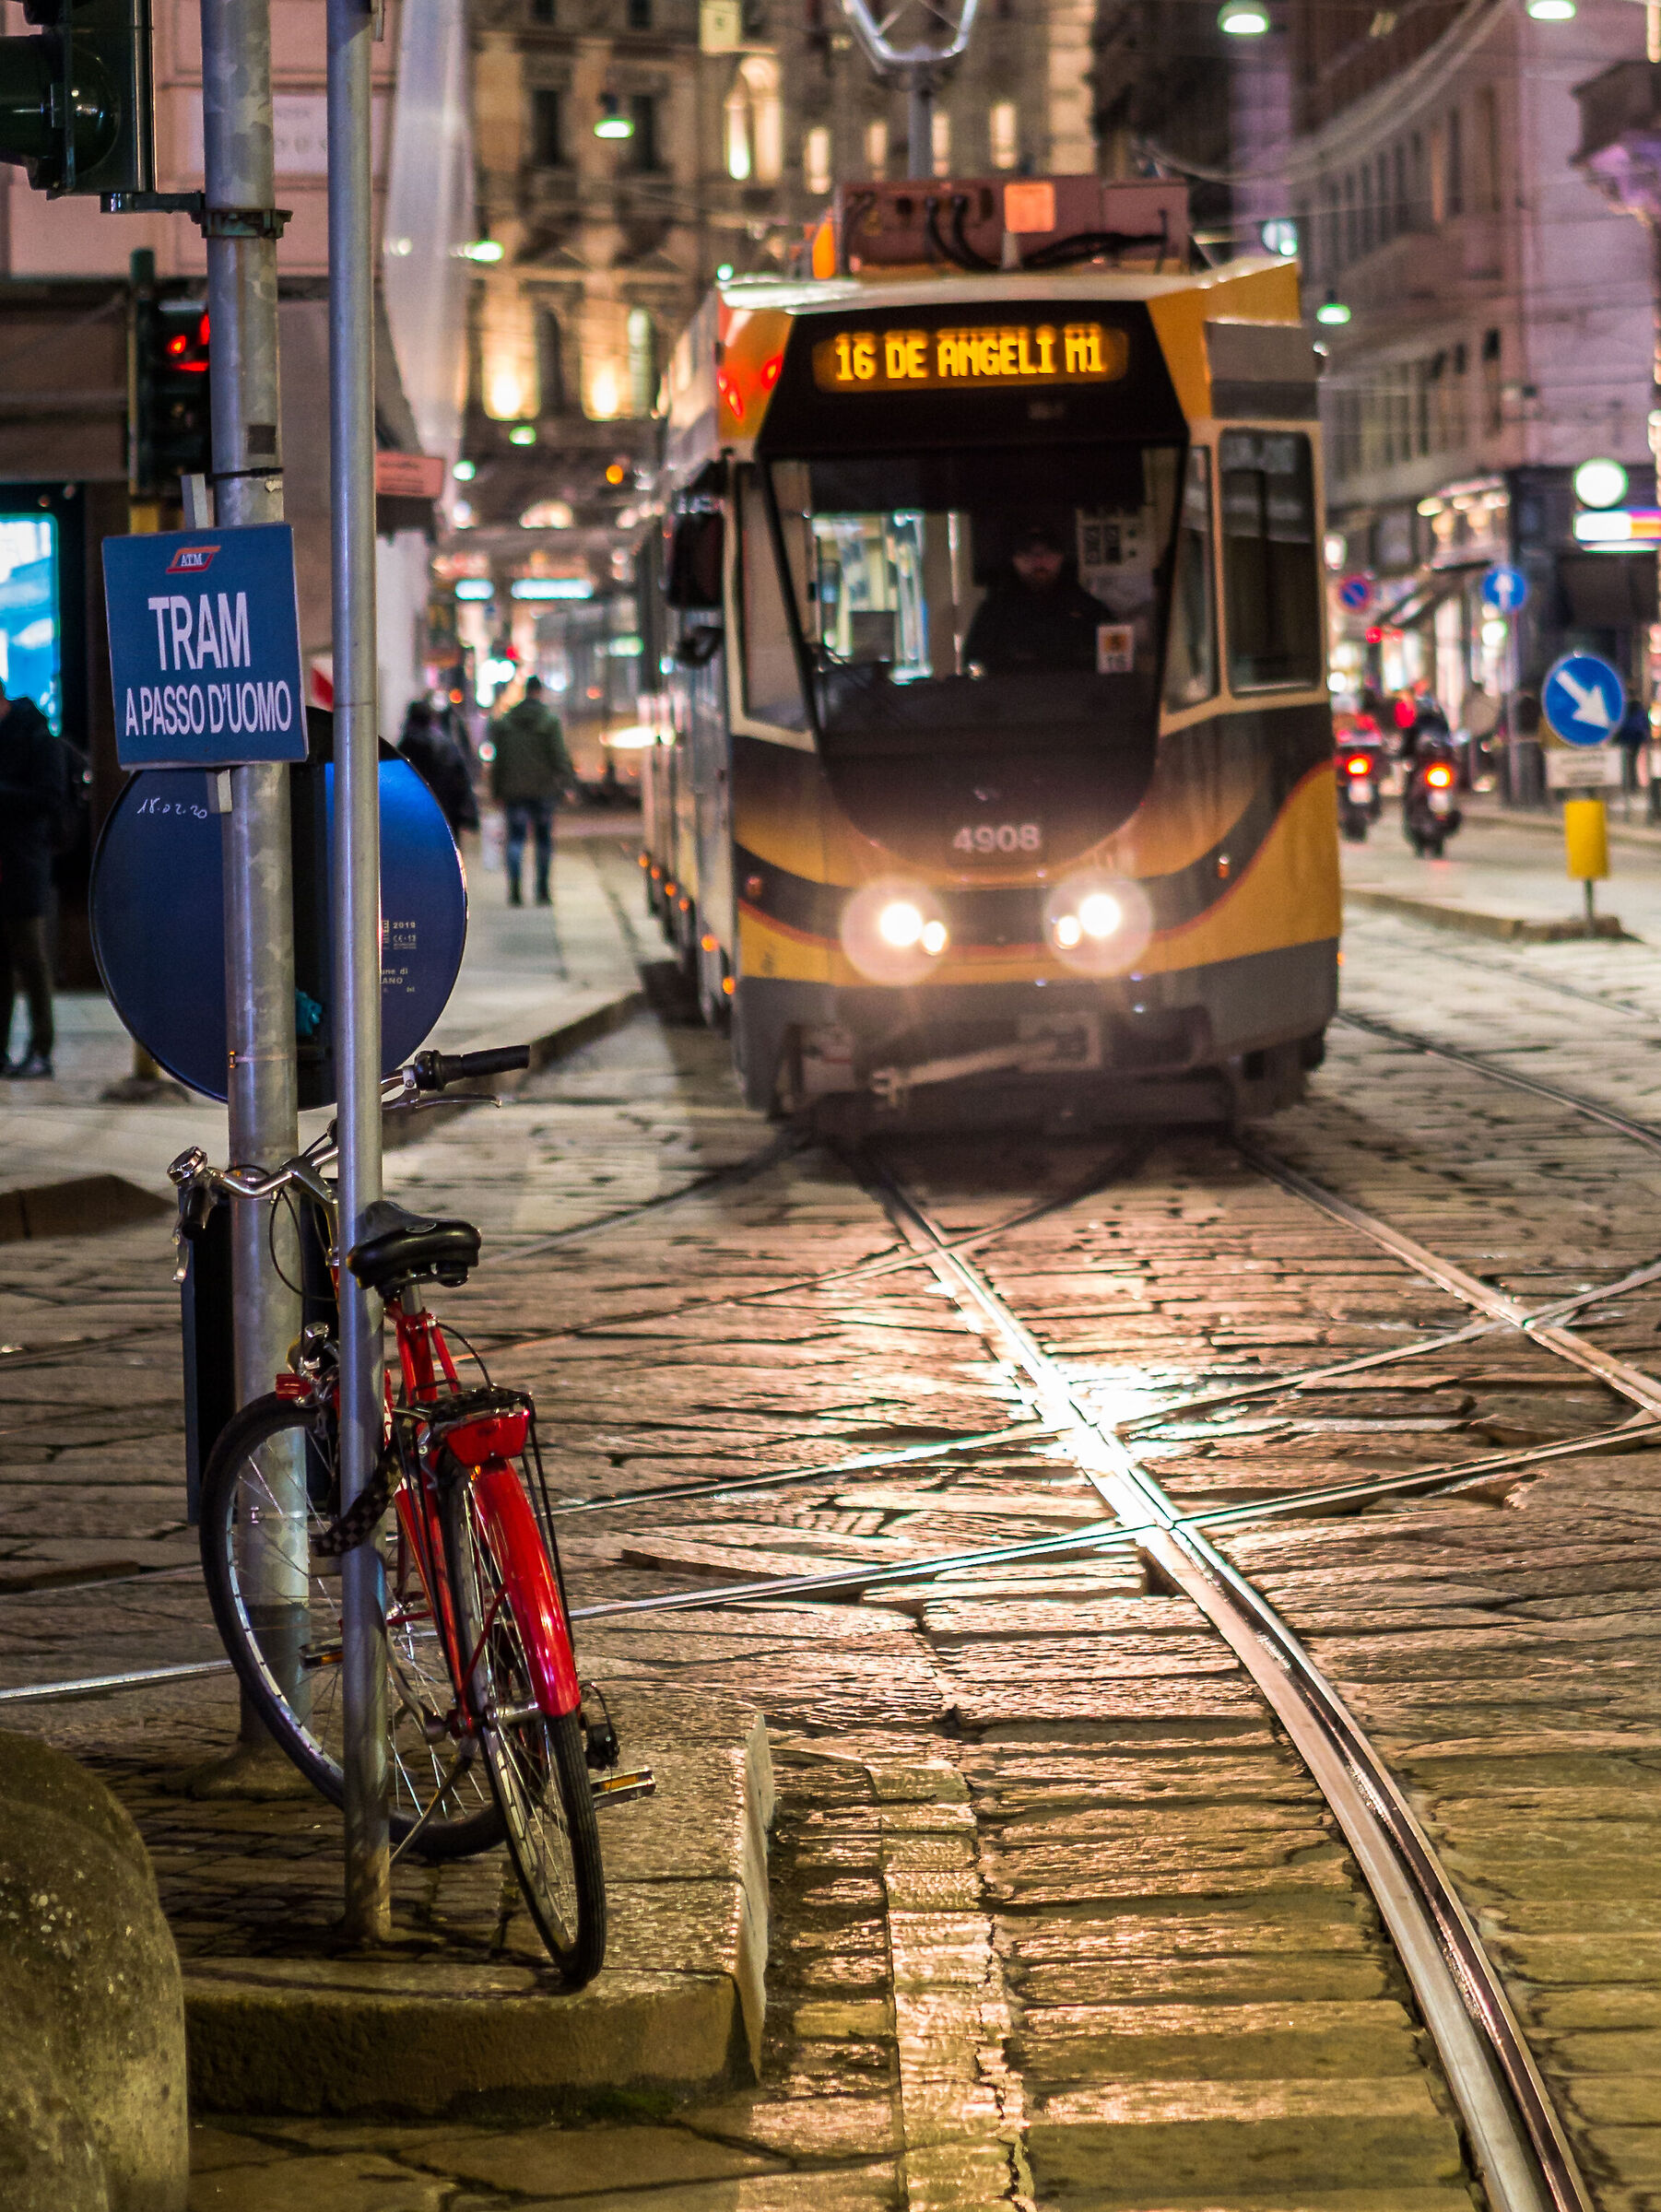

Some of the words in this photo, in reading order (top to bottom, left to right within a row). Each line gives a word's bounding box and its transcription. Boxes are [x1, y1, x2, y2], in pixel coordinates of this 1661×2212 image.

[836, 337, 875, 381] 16
[886, 335, 928, 379] DE
[937, 332, 1055, 377] ANGELI
[1065, 328, 1105, 373] M1
[181, 553, 204, 567] ATM
[147, 592, 251, 671] TRAM
[125, 688, 139, 736] A
[140, 684, 205, 735] PASSO
[207, 680, 292, 734] D'UOMO
[953, 823, 1042, 853] 4908
